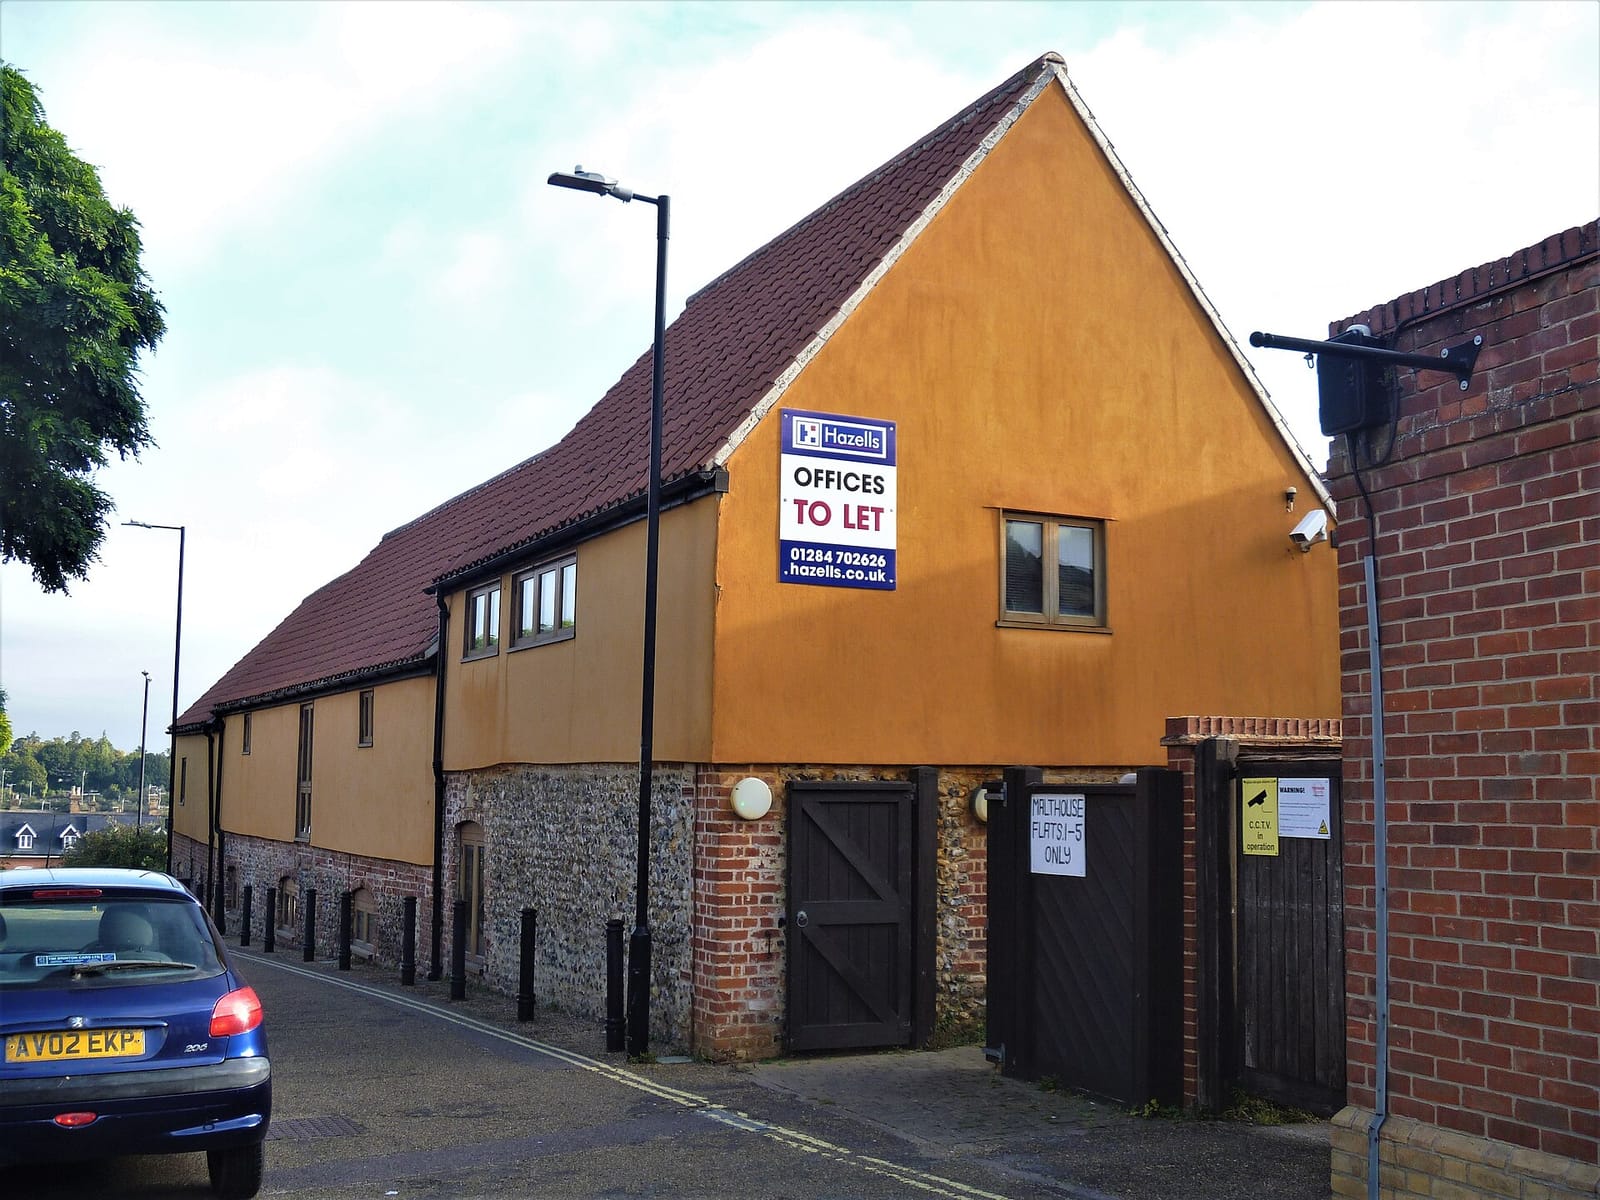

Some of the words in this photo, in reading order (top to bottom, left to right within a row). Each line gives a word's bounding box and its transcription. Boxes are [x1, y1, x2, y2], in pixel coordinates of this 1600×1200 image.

[825, 427, 880, 449] Hazells
[794, 466, 885, 495] OFFICES
[793, 498, 832, 526] TO
[843, 503, 885, 531] LET
[790, 547, 833, 563] 01284
[836, 551, 886, 567] 702626
[790, 562, 886, 582] hazells.co.uk
[1032, 798, 1084, 818] MALTHOUSE
[1257, 831, 1264, 840] in
[1044, 845, 1072, 865] ONLY
[1247, 843, 1275, 852] operation
[15, 1032, 80, 1057] AV02
[88, 1029, 135, 1053] EKP
[184, 1042, 208, 1053] 206
